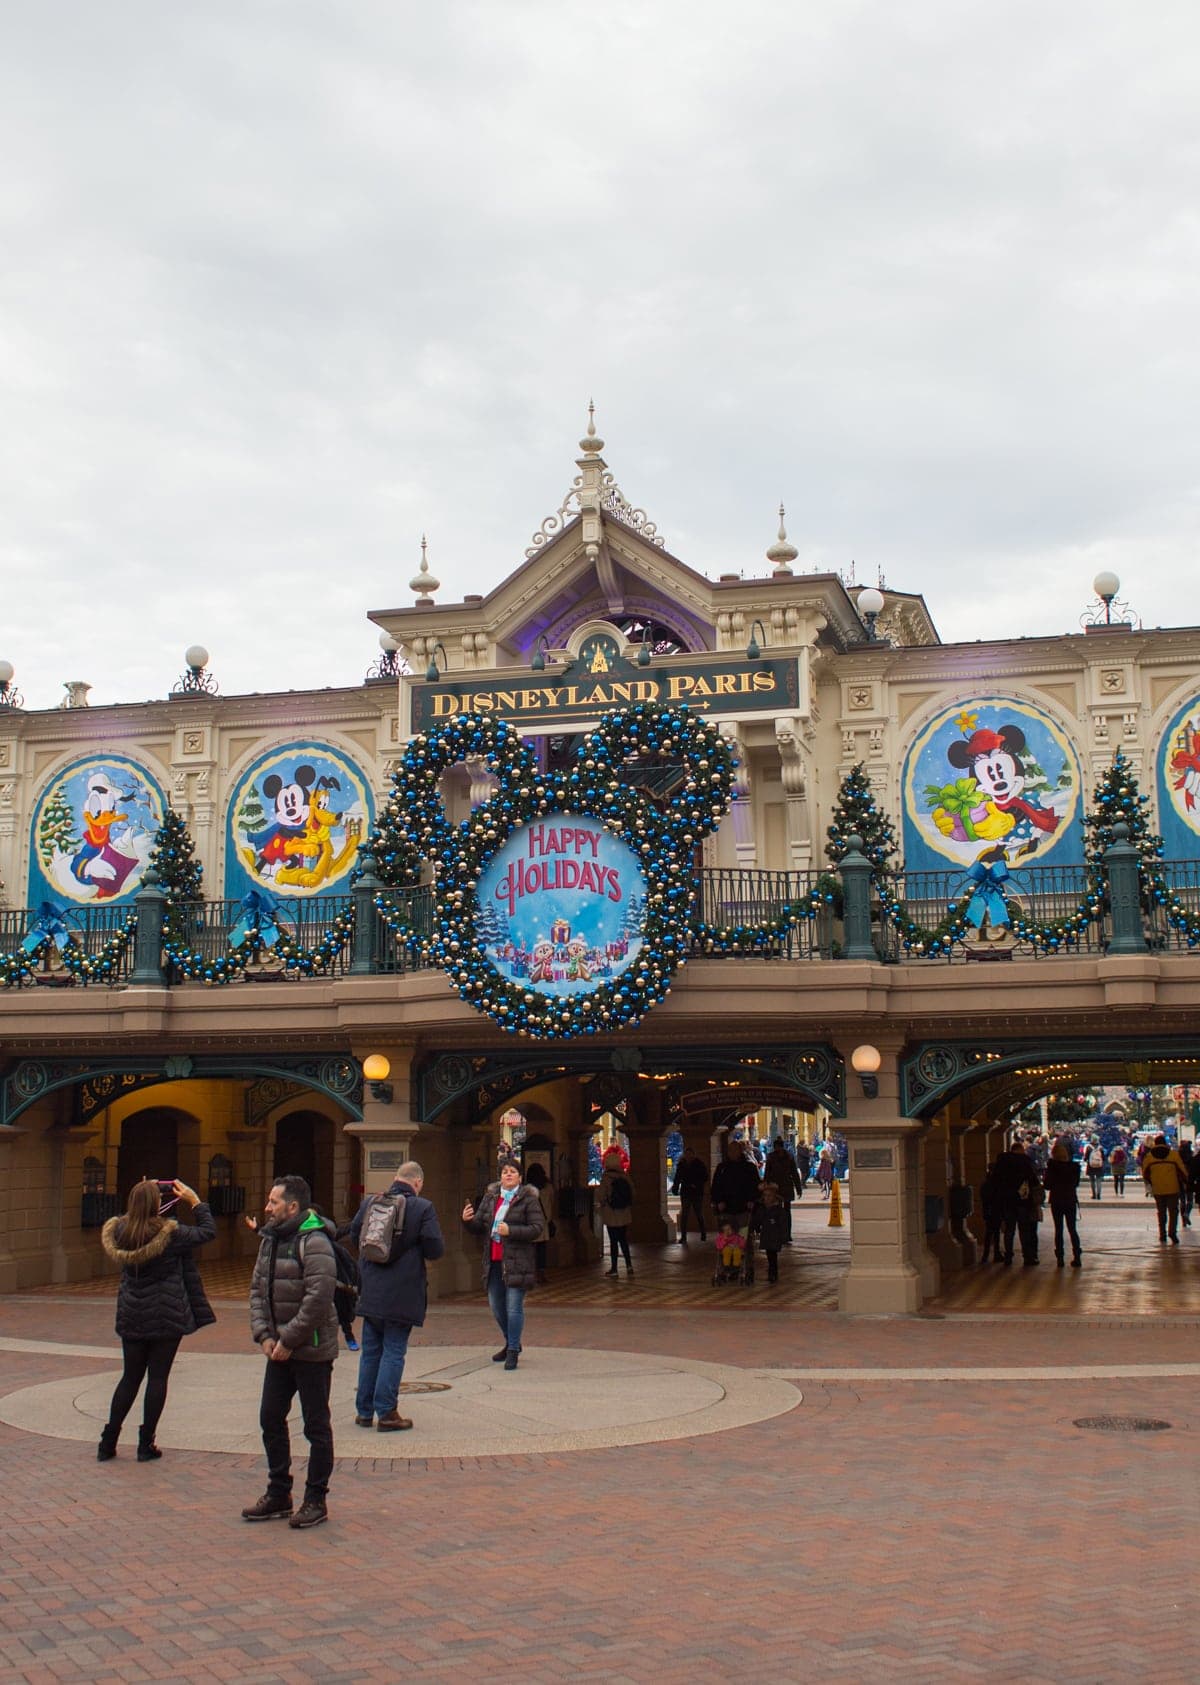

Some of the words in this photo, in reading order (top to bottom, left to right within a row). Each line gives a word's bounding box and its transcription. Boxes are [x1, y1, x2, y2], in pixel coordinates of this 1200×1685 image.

[430, 681, 660, 717] DISNEYLAND
[666, 671, 777, 700] PARIS
[528, 824, 602, 859] HAPPY
[495, 858, 622, 918] HOLIDAYS
